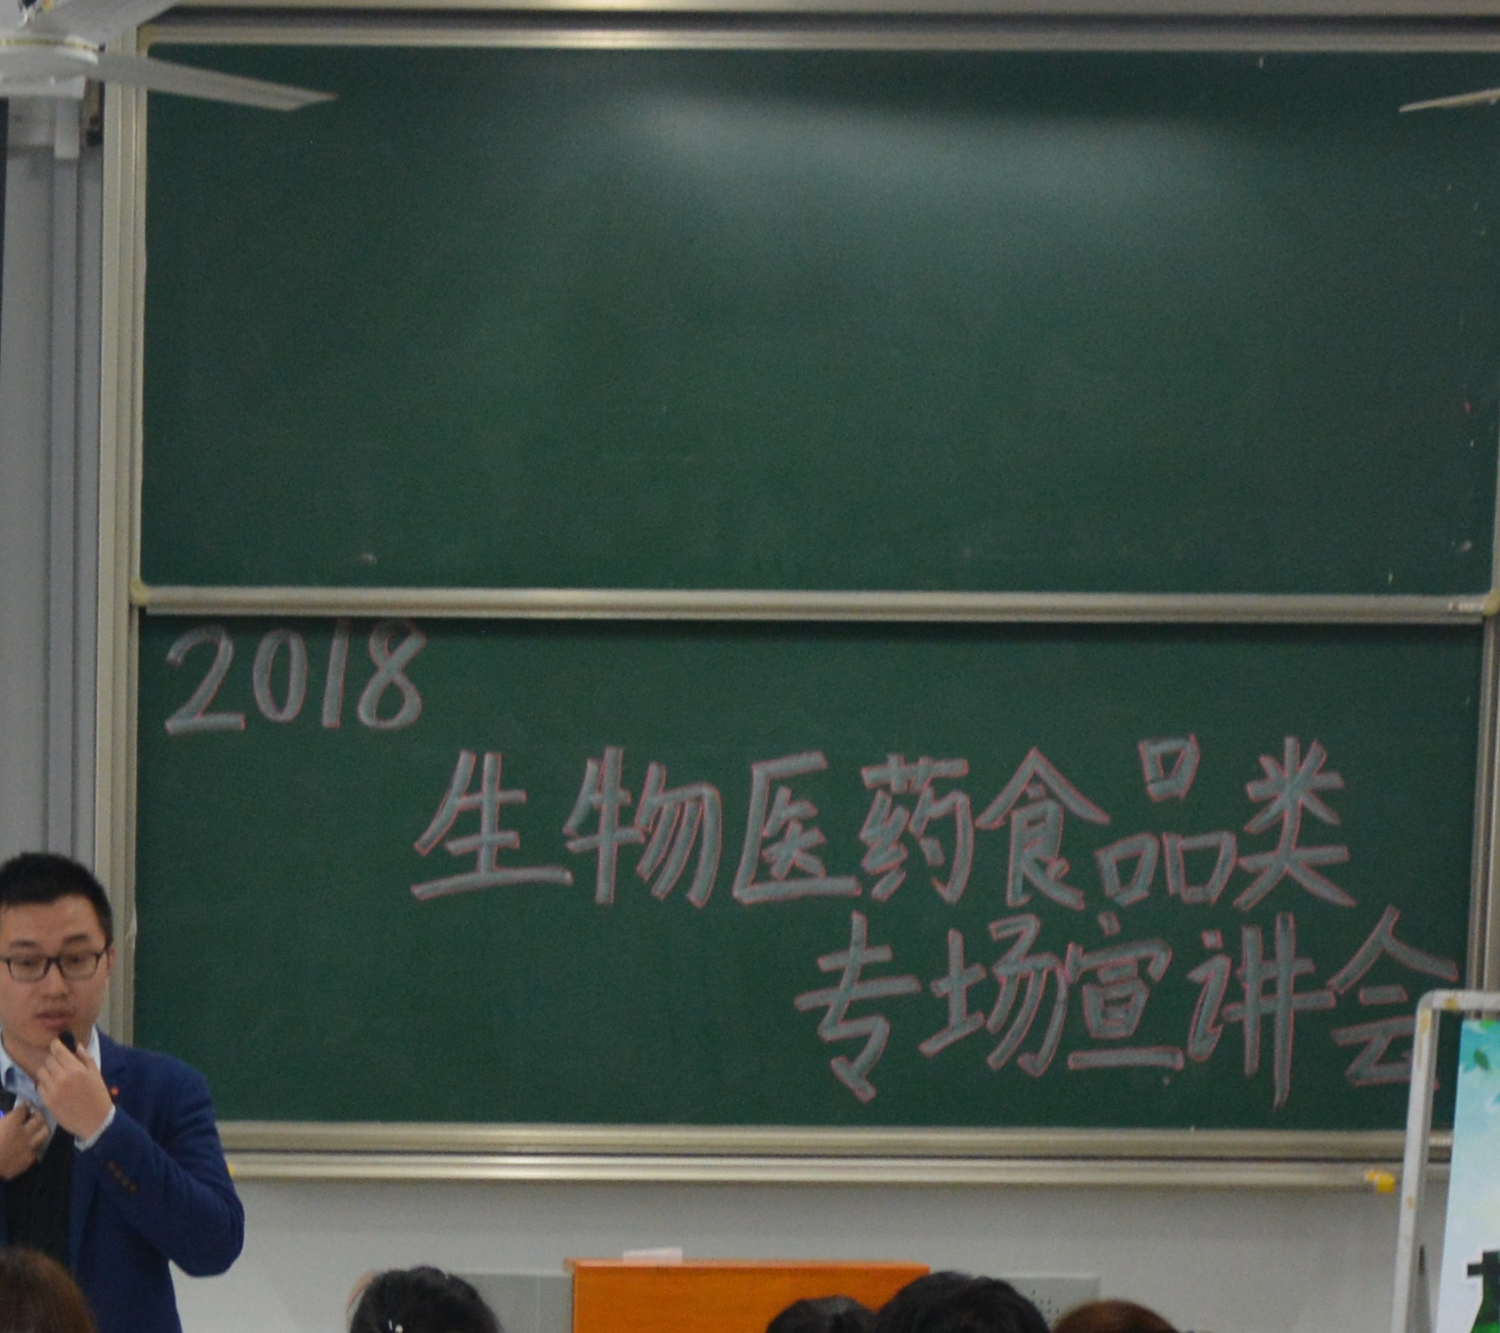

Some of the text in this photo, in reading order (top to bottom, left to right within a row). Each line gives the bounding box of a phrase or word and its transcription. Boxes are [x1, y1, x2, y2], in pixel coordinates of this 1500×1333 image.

[164, 618, 427, 735] 2018
[410, 733, 1357, 909] 生物医药食品类
[795, 905, 1458, 1110] 专场宣讲会
